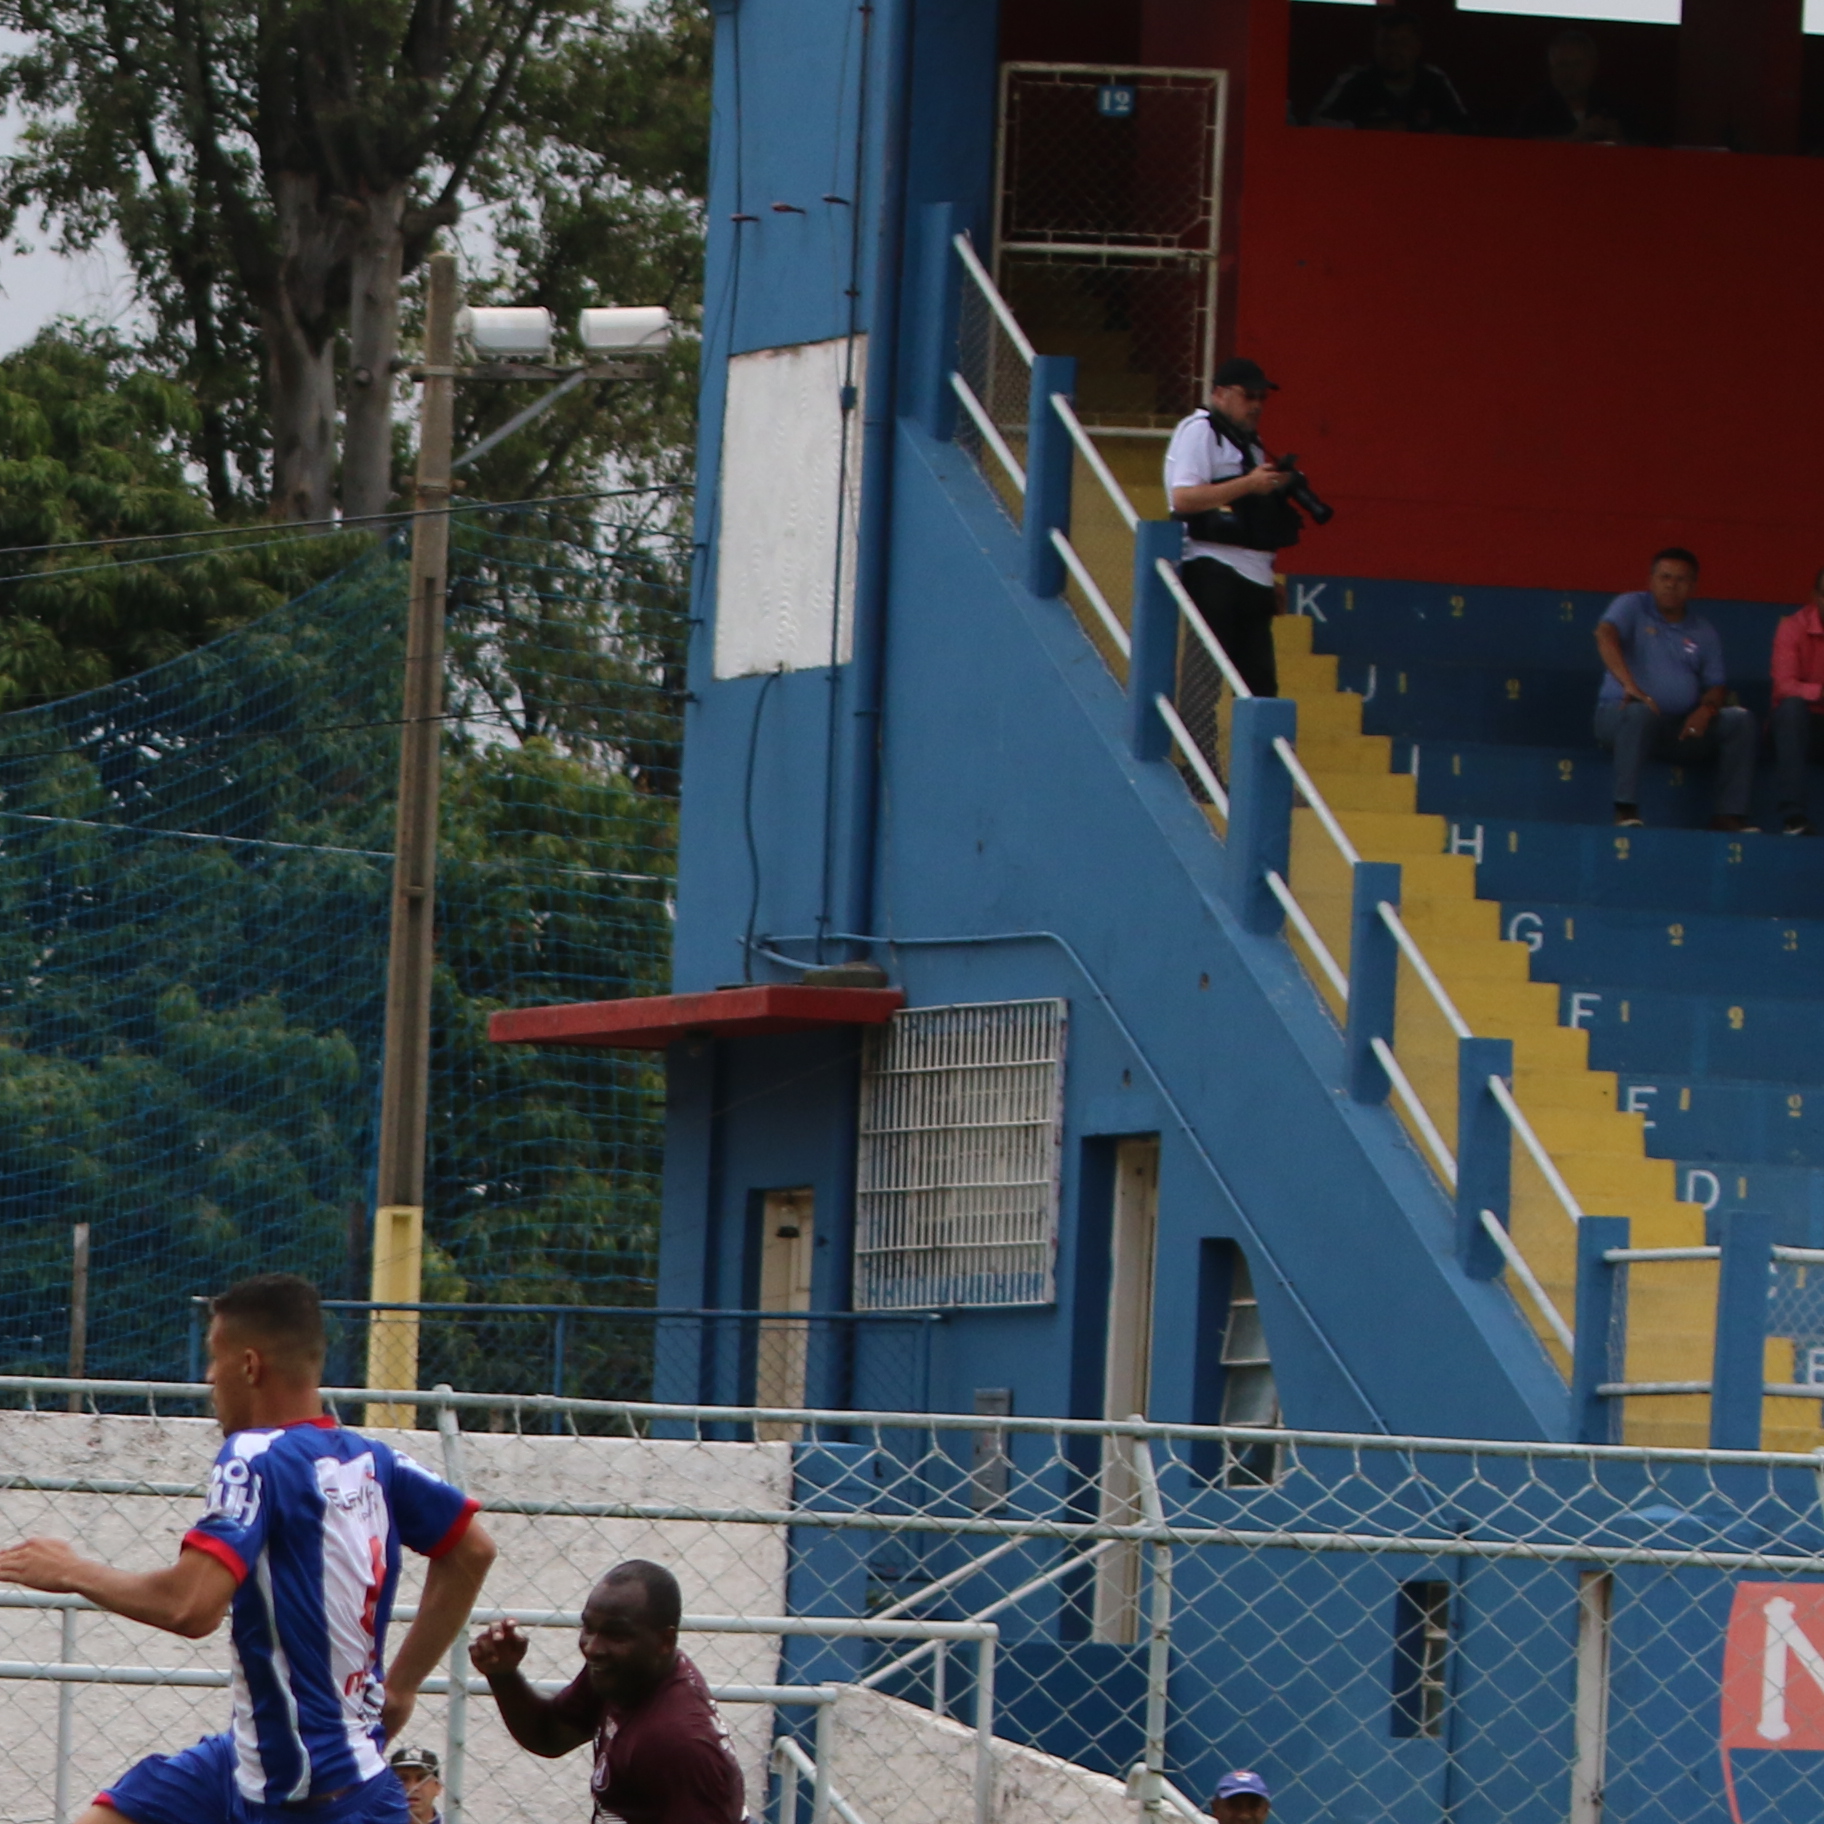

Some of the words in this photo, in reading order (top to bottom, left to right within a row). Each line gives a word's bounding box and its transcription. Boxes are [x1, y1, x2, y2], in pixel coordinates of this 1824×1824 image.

[1102, 90, 1130, 110] 12
[1296, 583, 1327, 622] K
[1452, 823, 1484, 865] H
[1508, 912, 1544, 952] G
[1686, 1169, 1721, 1211] D
